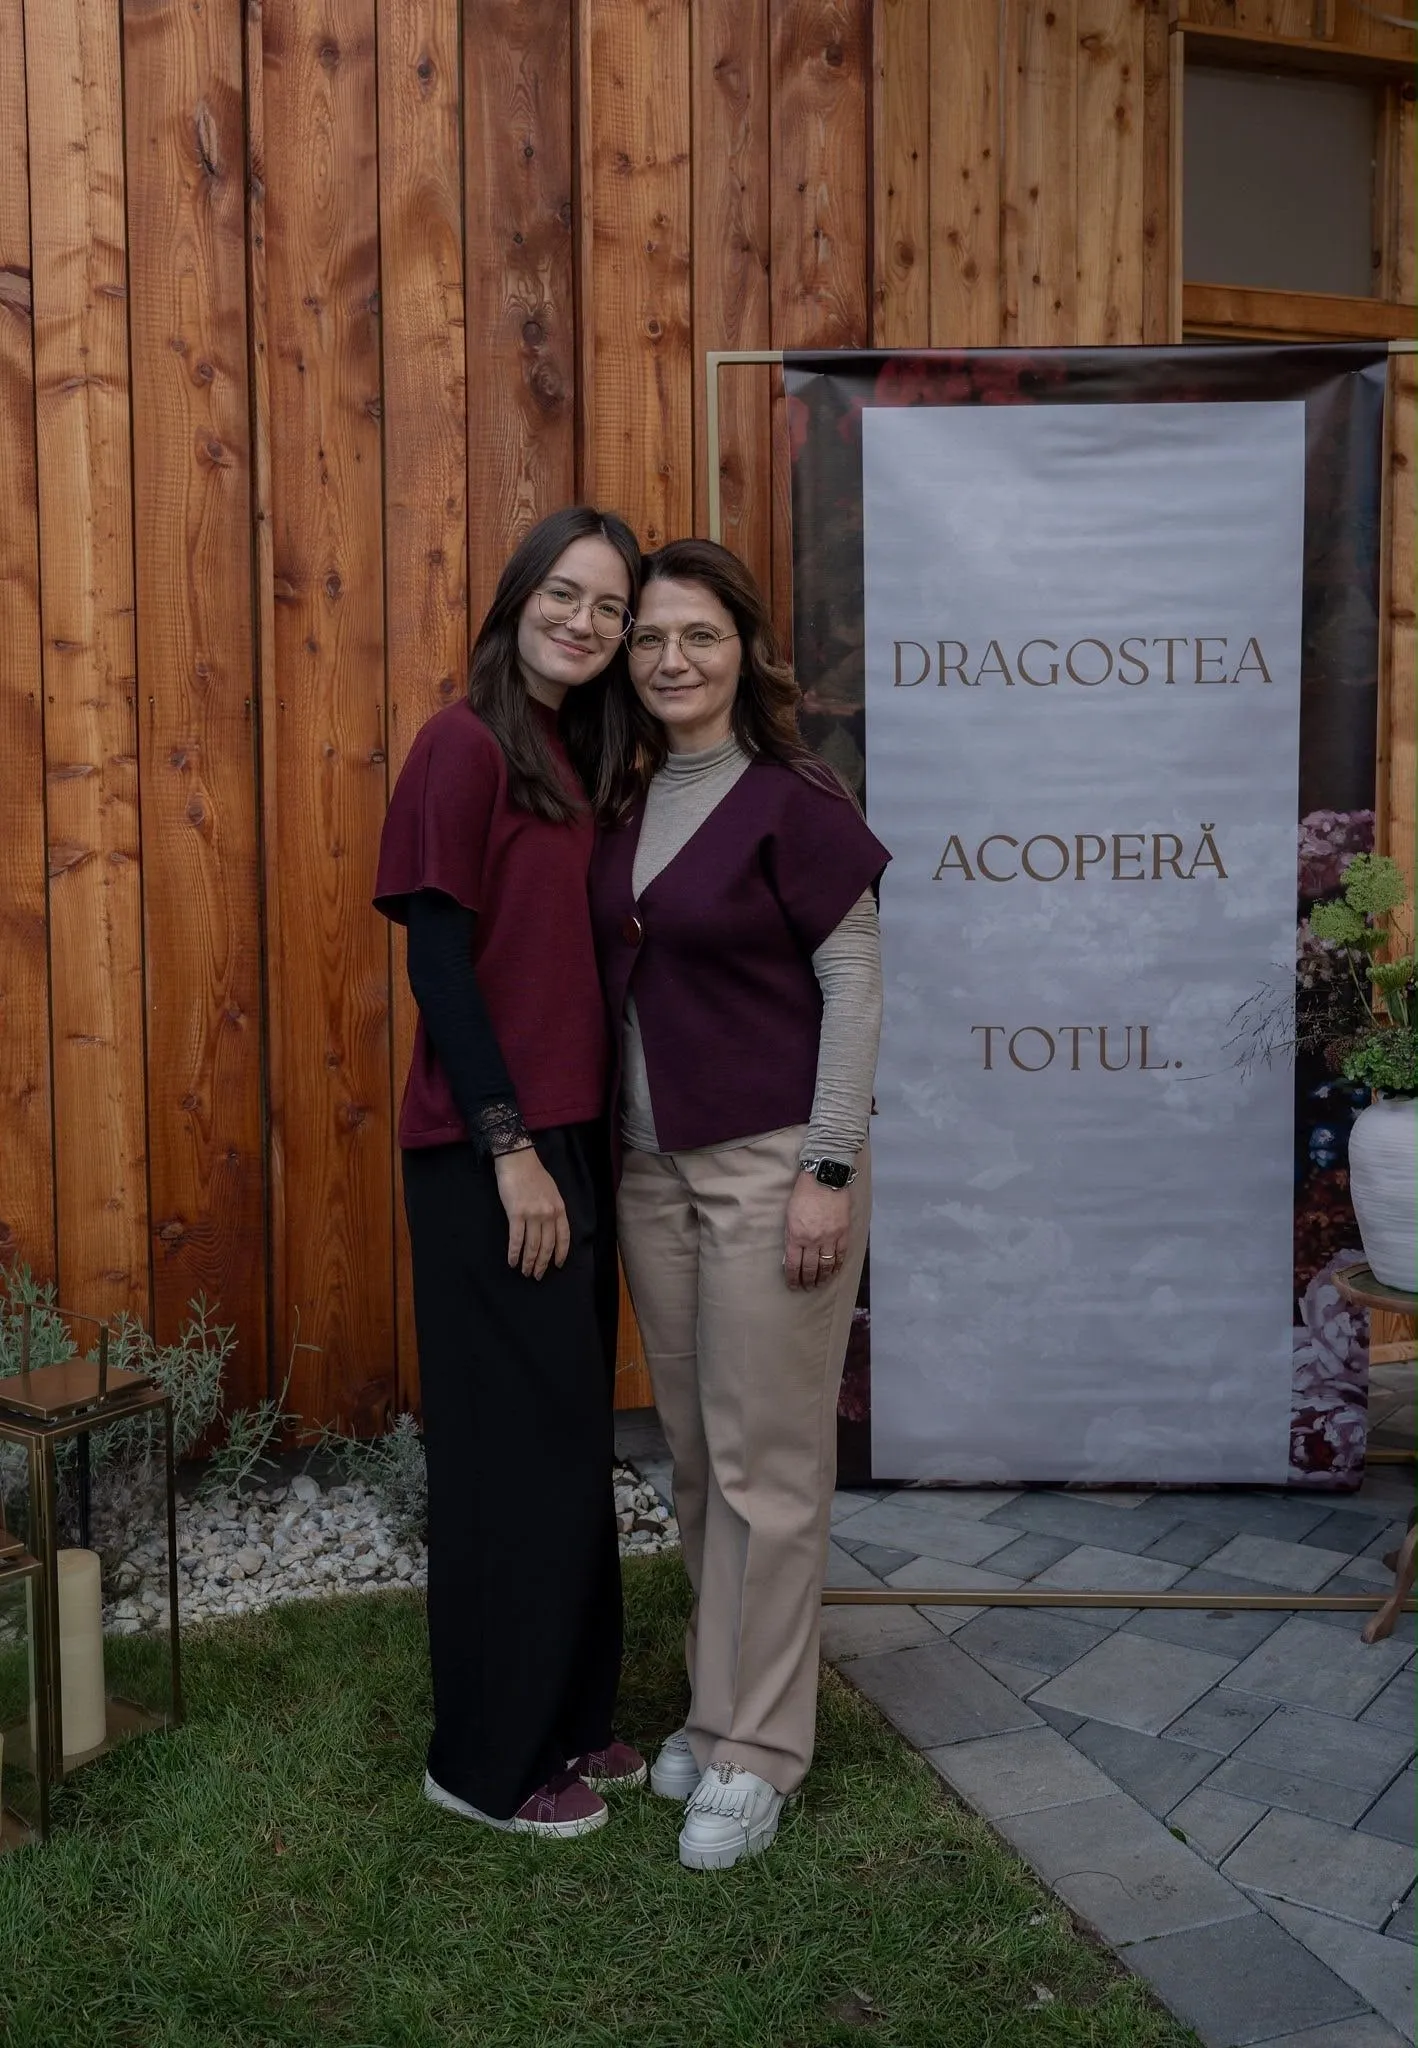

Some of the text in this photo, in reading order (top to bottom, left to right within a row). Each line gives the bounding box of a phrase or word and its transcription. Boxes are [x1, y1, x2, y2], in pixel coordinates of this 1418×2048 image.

[893, 637, 1273, 688] DRAGOSTEA
[932, 822, 1228, 882] ACOPERĂ
[971, 1025, 1184, 1072] TOTUL.
